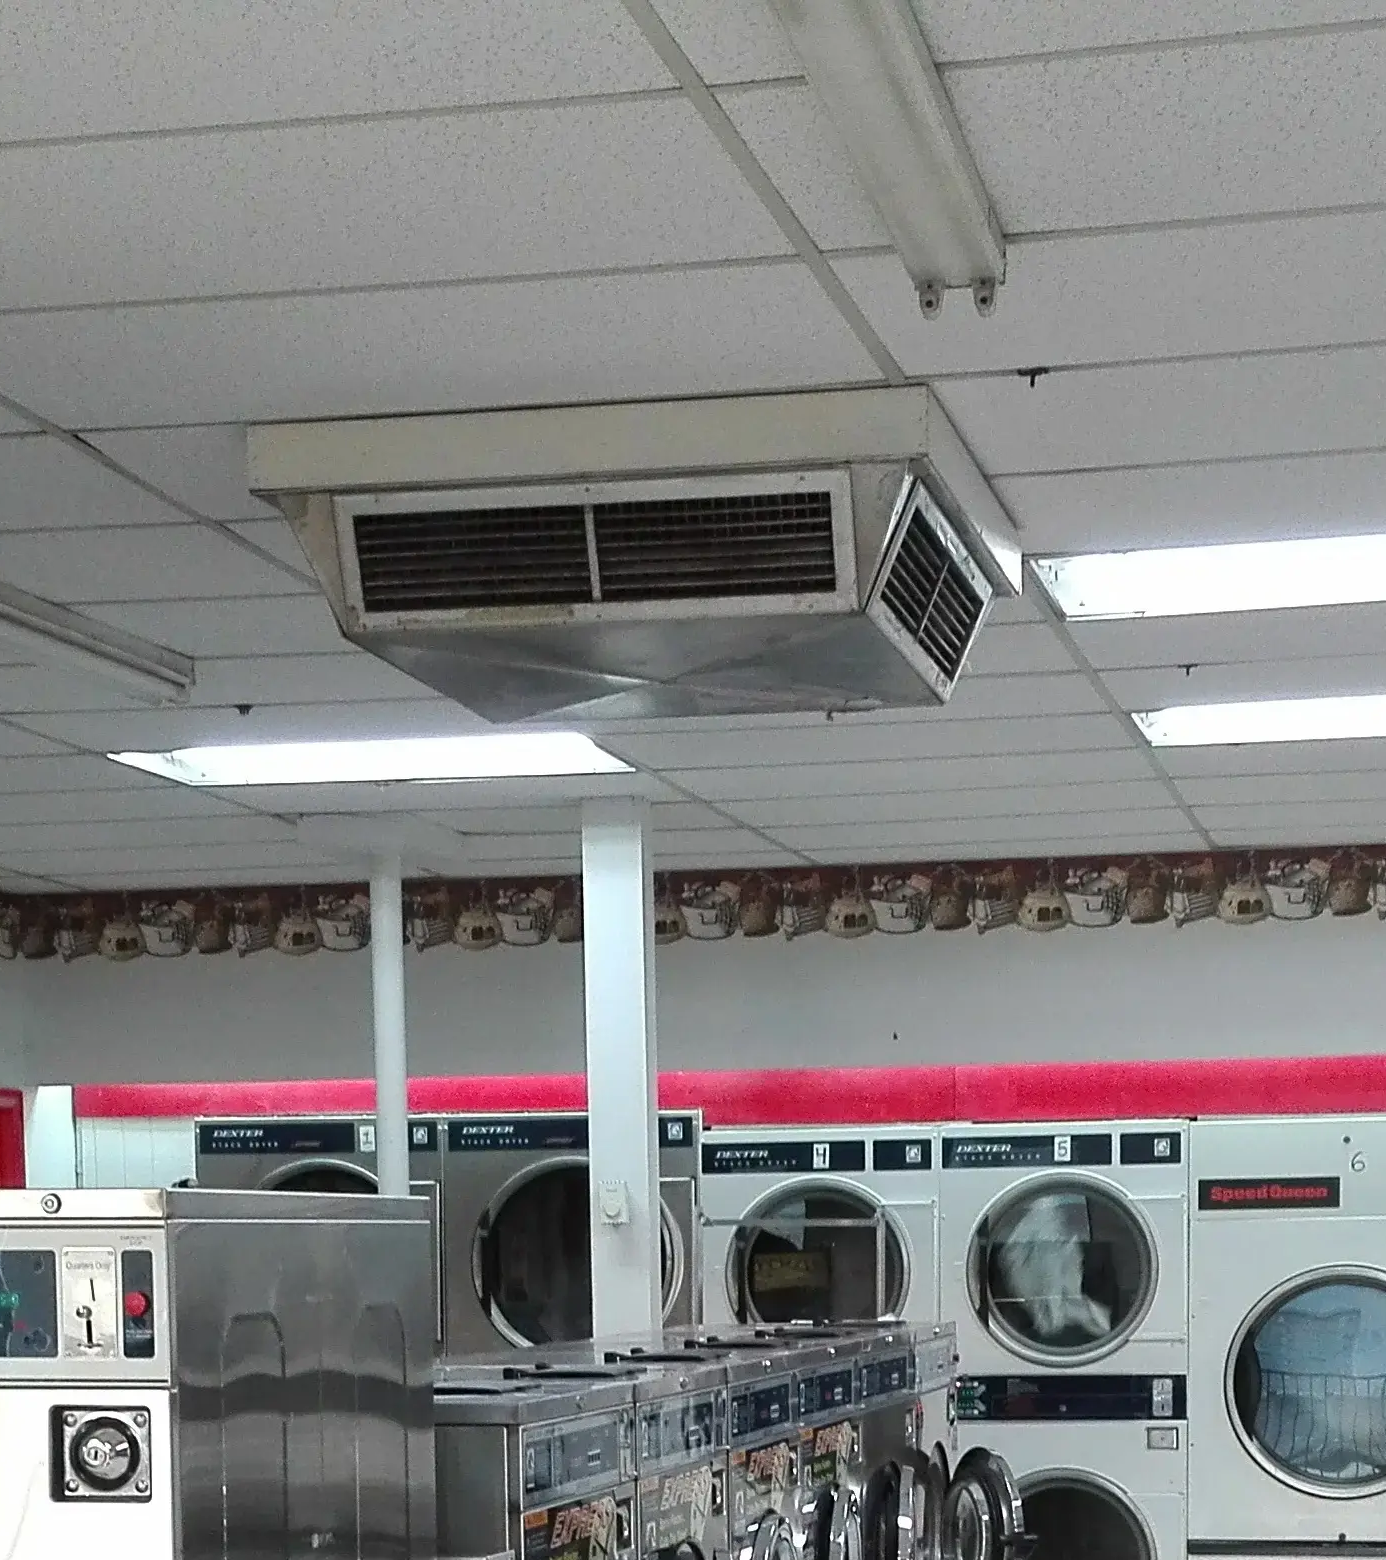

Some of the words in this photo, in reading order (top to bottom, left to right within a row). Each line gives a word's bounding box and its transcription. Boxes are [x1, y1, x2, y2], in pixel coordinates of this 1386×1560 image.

[213, 1129, 264, 1138] DEXTER
[462, 1126, 515, 1135] DEXTER
[956, 1143, 1012, 1153] DEXTER
[1056, 1138, 1069, 1159] 5
[715, 1150, 769, 1159] DEXTER
[815, 1144, 828, 1167] 4
[1350, 1151, 1366, 1172] 6
